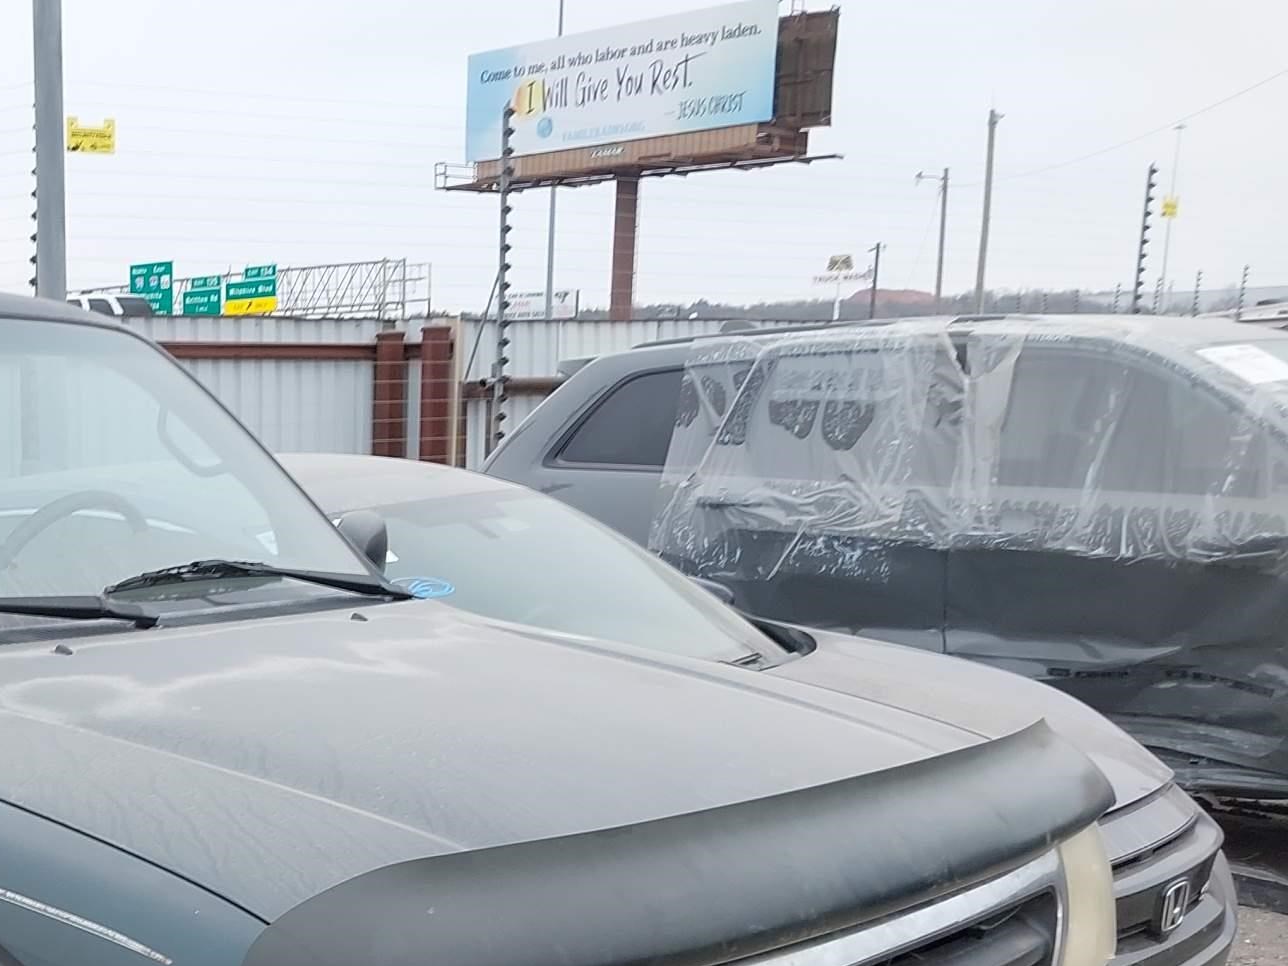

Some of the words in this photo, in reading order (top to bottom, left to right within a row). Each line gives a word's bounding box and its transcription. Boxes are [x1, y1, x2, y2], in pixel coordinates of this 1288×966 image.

[480, 68, 513, 85] Come
[513, 64, 525, 78] to
[527, 62, 548, 75] me,
[550, 54, 566, 70] all
[568, 51, 594, 67] who
[594, 46, 627, 64] labor
[629, 43, 654, 57] and
[656, 37, 678, 51] are
[680, 29, 720, 50] heavy
[720, 22, 762, 39] laden.
[525, 81, 536, 114] I
[542, 75, 568, 112] Will
[575, 72, 609, 109] Give
[616, 65, 643, 100] You
[649, 51, 708, 95] Rest.
[676, 97, 708, 121] JESUS
[708, 91, 748, 114] CHRIST
